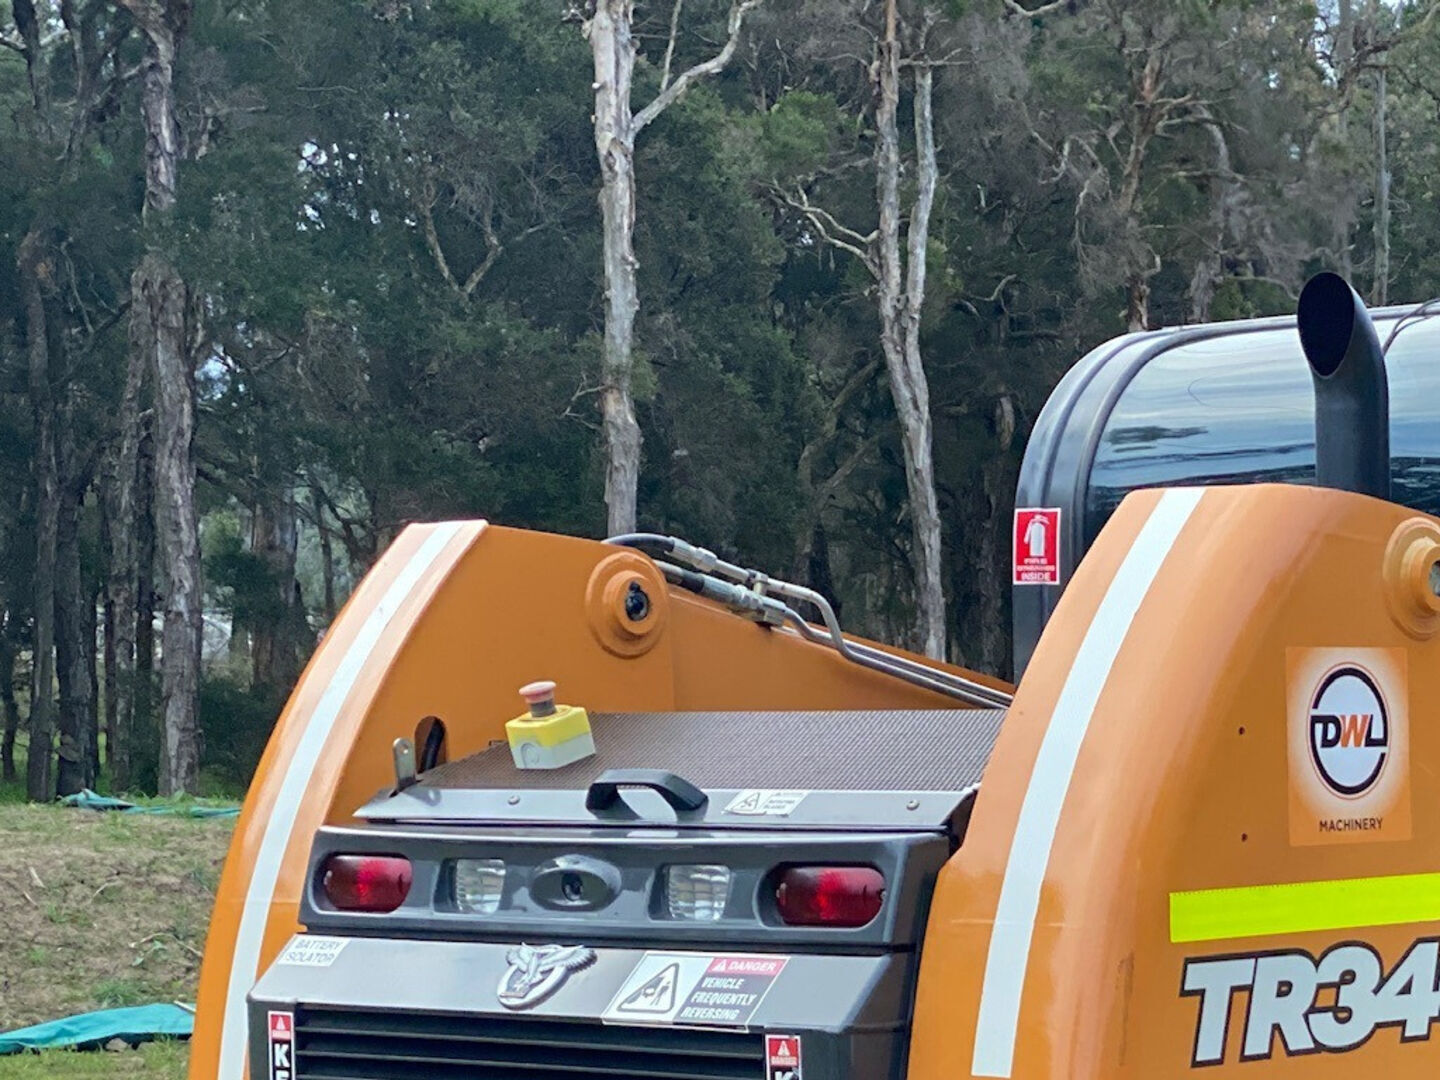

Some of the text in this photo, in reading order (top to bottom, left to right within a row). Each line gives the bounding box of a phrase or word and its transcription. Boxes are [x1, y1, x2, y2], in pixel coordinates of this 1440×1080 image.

[1310, 714, 1388, 749] DWL
[1319, 818, 1384, 833] MACHINERY
[295, 939, 343, 951] BATTERY
[728, 959, 777, 972] DANGER
[701, 976, 746, 989] VEHICLE
[690, 991, 758, 1006] FREQUENTLY
[680, 1006, 741, 1020] REVERSING
